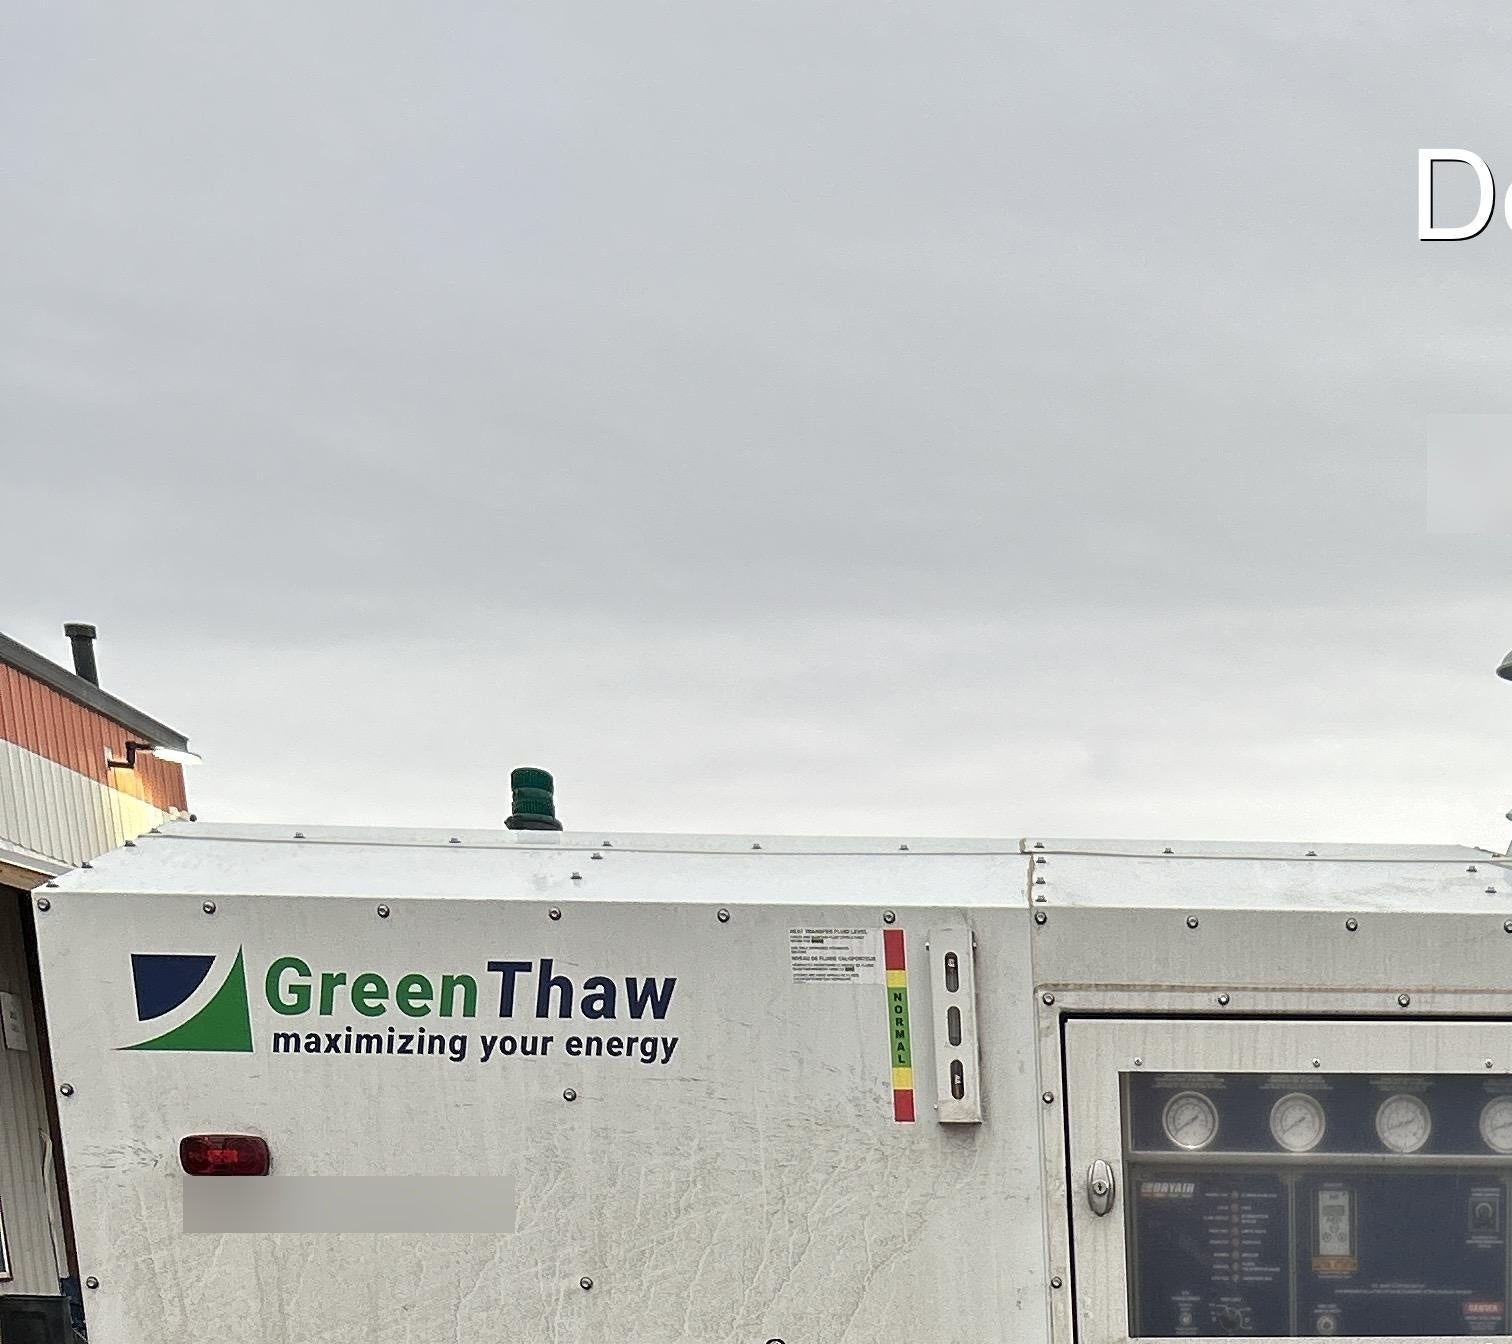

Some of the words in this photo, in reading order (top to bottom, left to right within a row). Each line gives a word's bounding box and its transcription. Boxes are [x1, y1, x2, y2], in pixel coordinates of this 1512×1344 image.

[272, 1026, 468, 1062] maximizing
[479, 1034, 554, 1063] your
[565, 1035, 679, 1065] energy
[893, 992, 906, 1064] NORMAL
